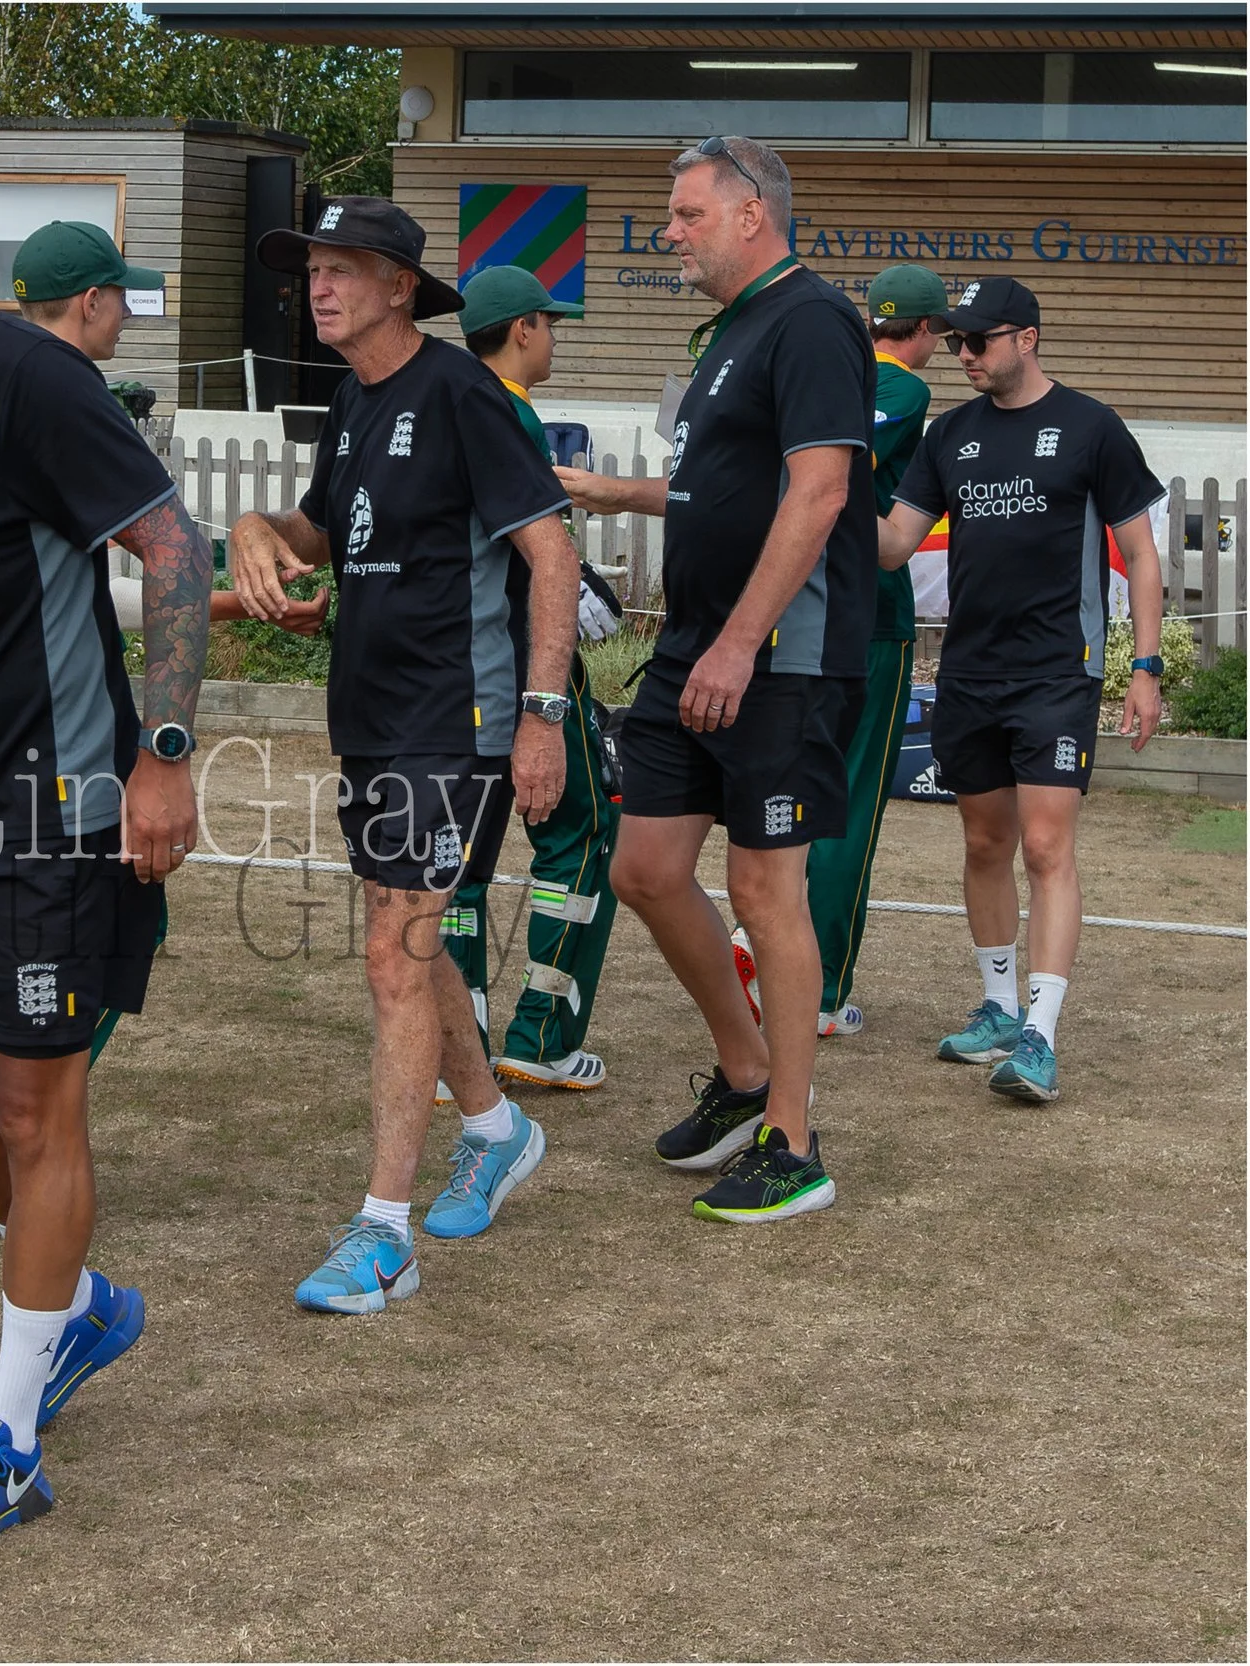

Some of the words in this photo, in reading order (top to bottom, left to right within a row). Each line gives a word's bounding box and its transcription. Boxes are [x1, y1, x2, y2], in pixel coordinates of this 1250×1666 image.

[1032, 219, 1246, 265] GUERNSE
[958, 475, 1034, 500] darwin
[962, 495, 1047, 519] escapes
[17, 963, 59, 973] GUERNSEY
[32, 1017, 47, 1026] PS
